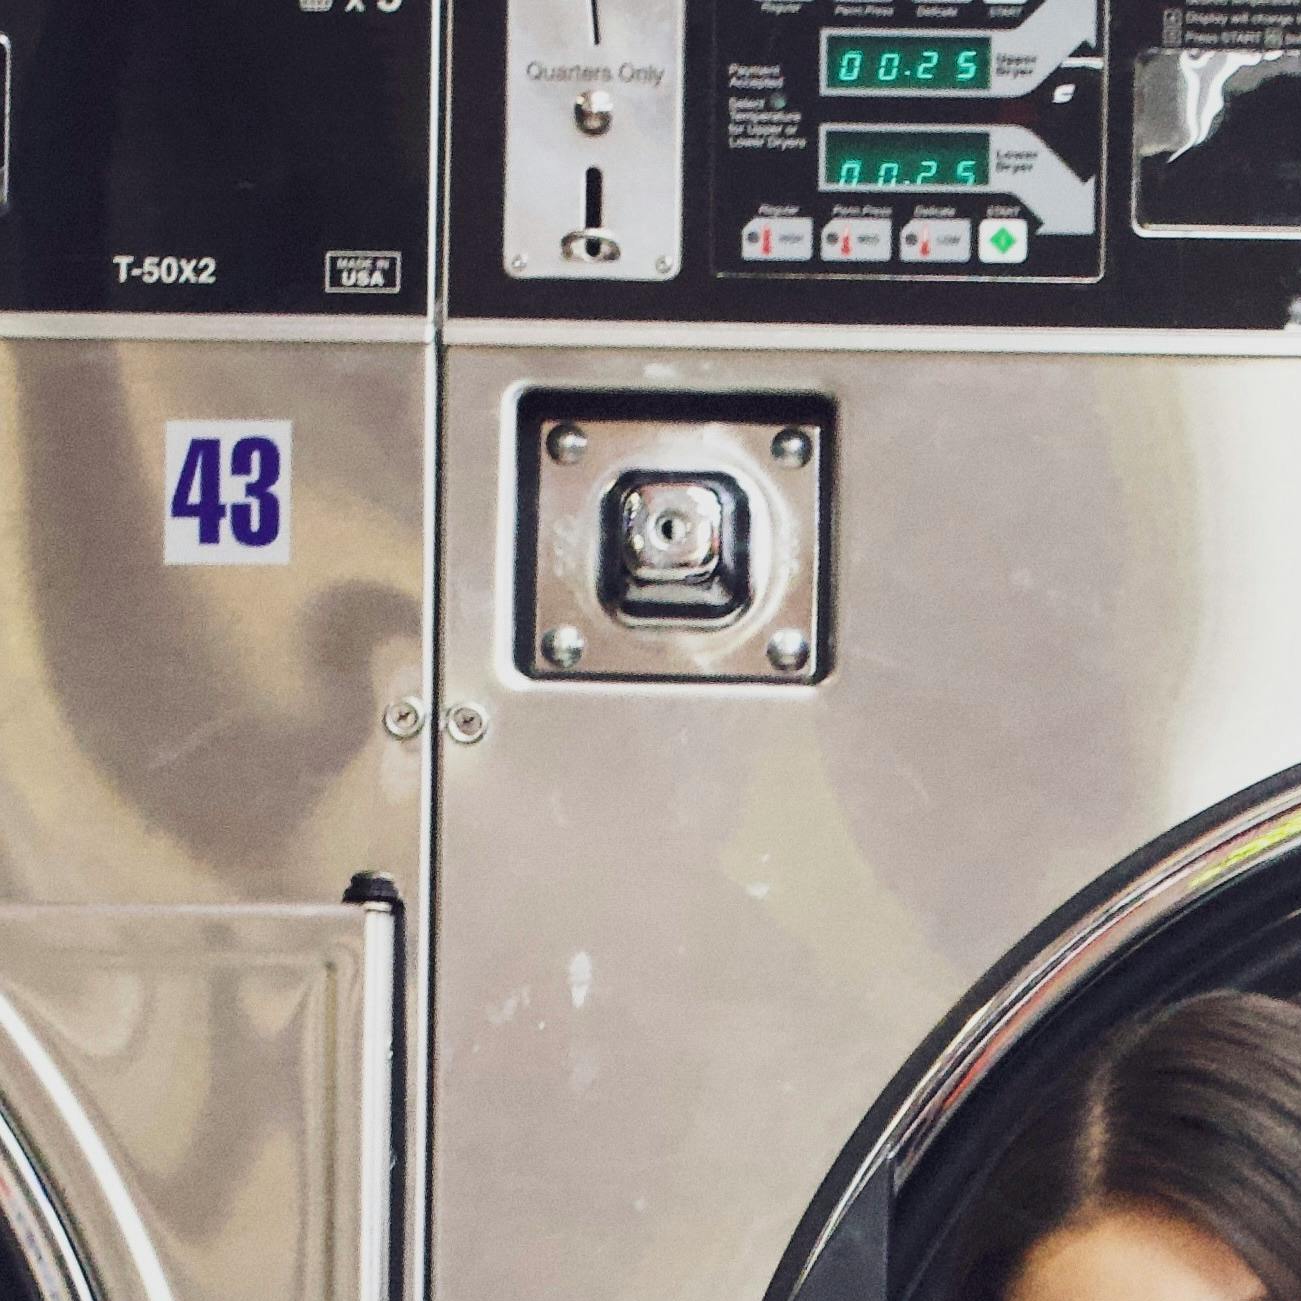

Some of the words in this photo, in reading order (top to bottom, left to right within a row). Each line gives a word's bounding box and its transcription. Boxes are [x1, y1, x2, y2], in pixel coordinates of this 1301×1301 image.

[525, 60, 612, 83] Quarters
[618, 61, 665, 87] Only
[996, 67, 1034, 79] Dryer
[728, 137, 764, 149] Lower
[767, 137, 807, 151] Dryers
[996, 149, 1038, 160] Lower
[996, 162, 1034, 175] Dryer
[112, 255, 217, 285] T-50X2
[336, 258, 374, 270] MADE
[376, 258, 391, 270] IN
[340, 270, 385, 288] USA
[170, 436, 281, 547] 43
